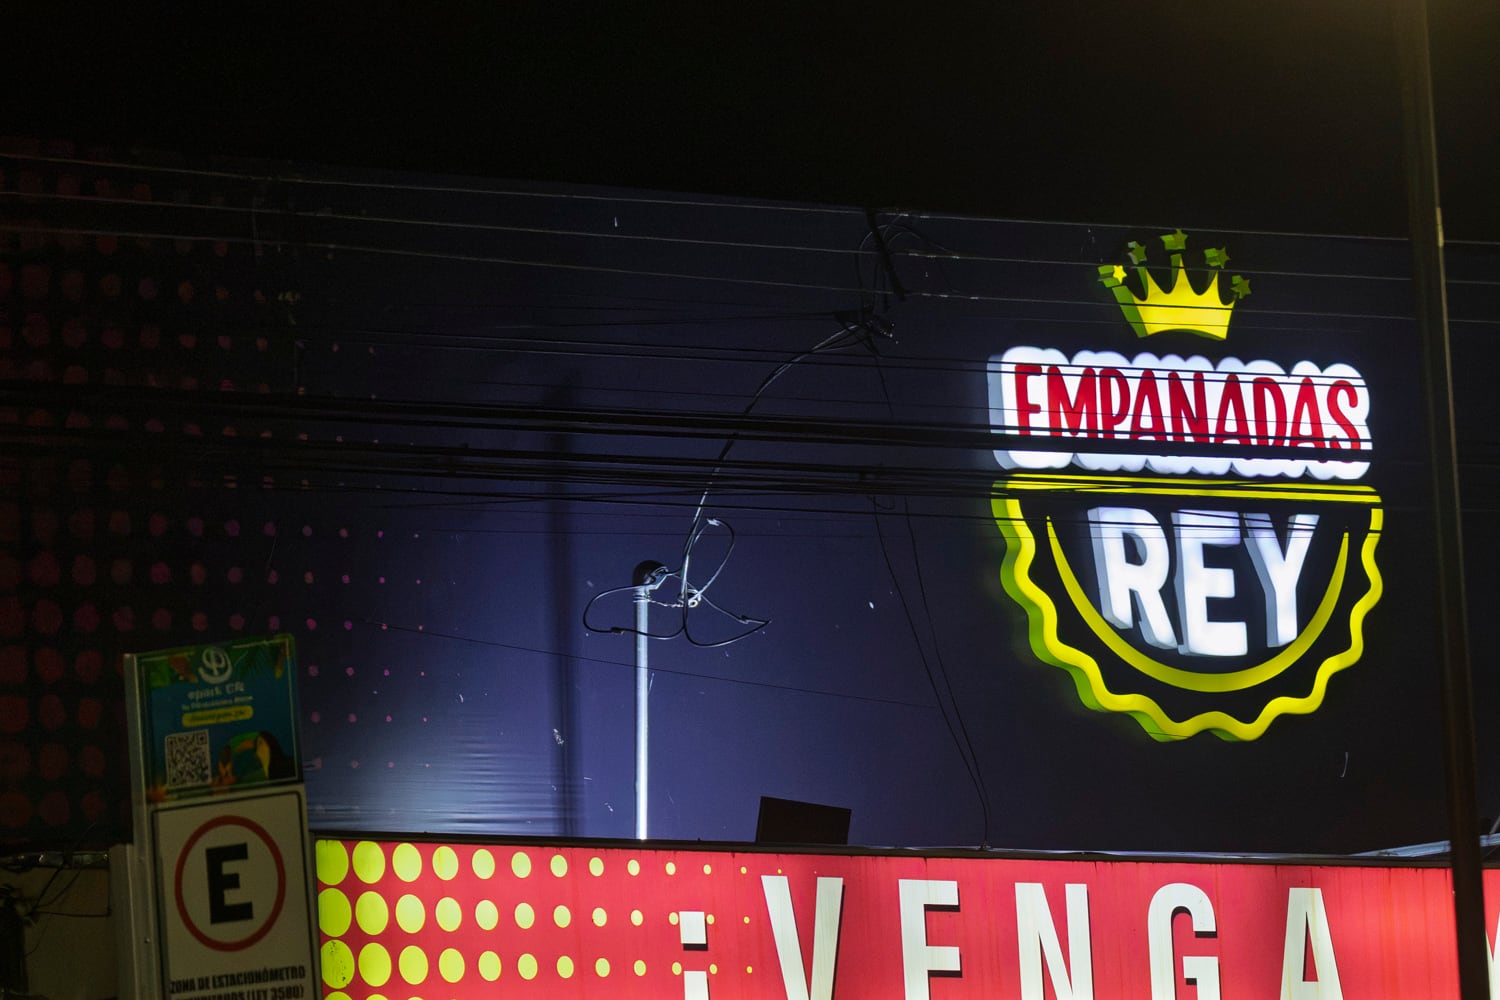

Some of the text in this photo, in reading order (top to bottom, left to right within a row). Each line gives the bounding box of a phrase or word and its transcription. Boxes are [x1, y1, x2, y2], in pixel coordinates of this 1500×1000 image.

[1013, 364, 1362, 463] EMPANADAS
[1087, 507, 1320, 657] REY
[205, 843, 253, 925] E
[170, 979, 196, 994] ZONA
[197, 976, 211, 990] DE
